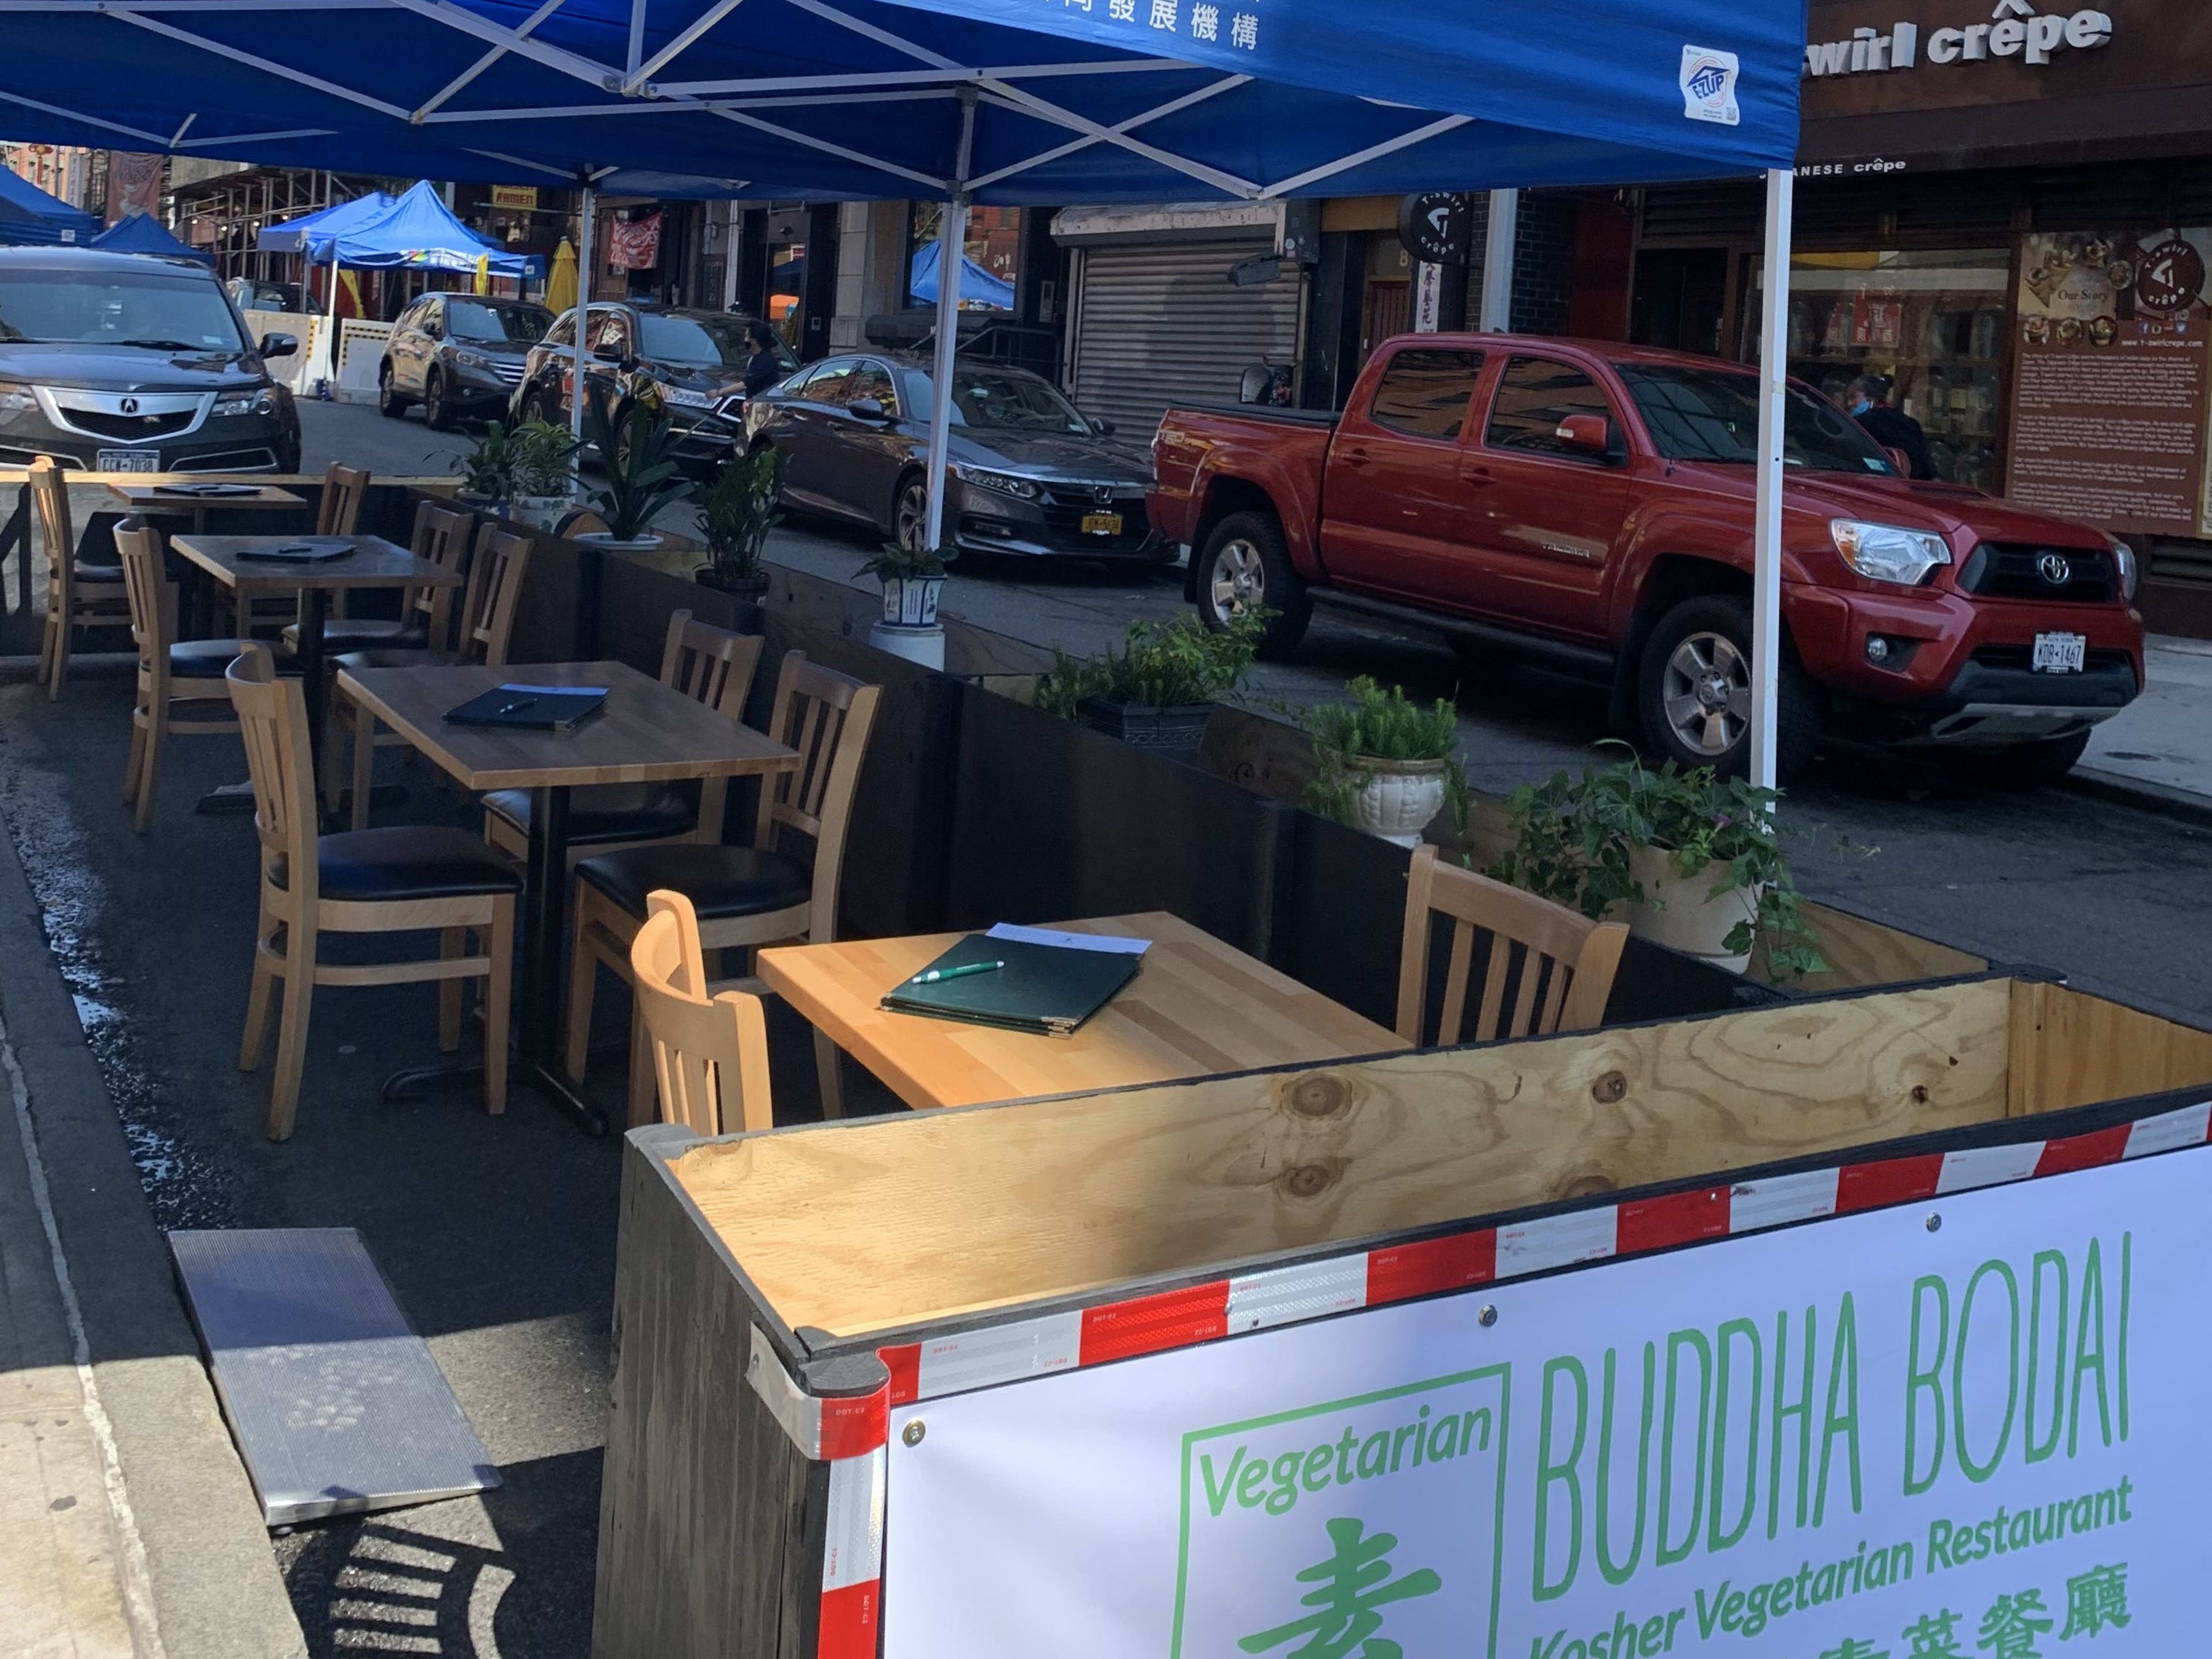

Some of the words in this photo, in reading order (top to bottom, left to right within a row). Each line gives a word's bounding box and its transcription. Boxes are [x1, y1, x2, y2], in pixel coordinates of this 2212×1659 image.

[1802, 21, 1918, 78] wirl
[1927, 0, 2112, 65] crêpe
[1854, 158, 1907, 172] crêpe
[1200, 1404, 1492, 1517] Vegetarian
[1532, 1291, 1862, 1602] BUDDHA
[1903, 1230, 2131, 1496] BODAI
[1694, 1541, 1914, 1641] Vegetarian
[1927, 1475, 2133, 1574] Restaurant
